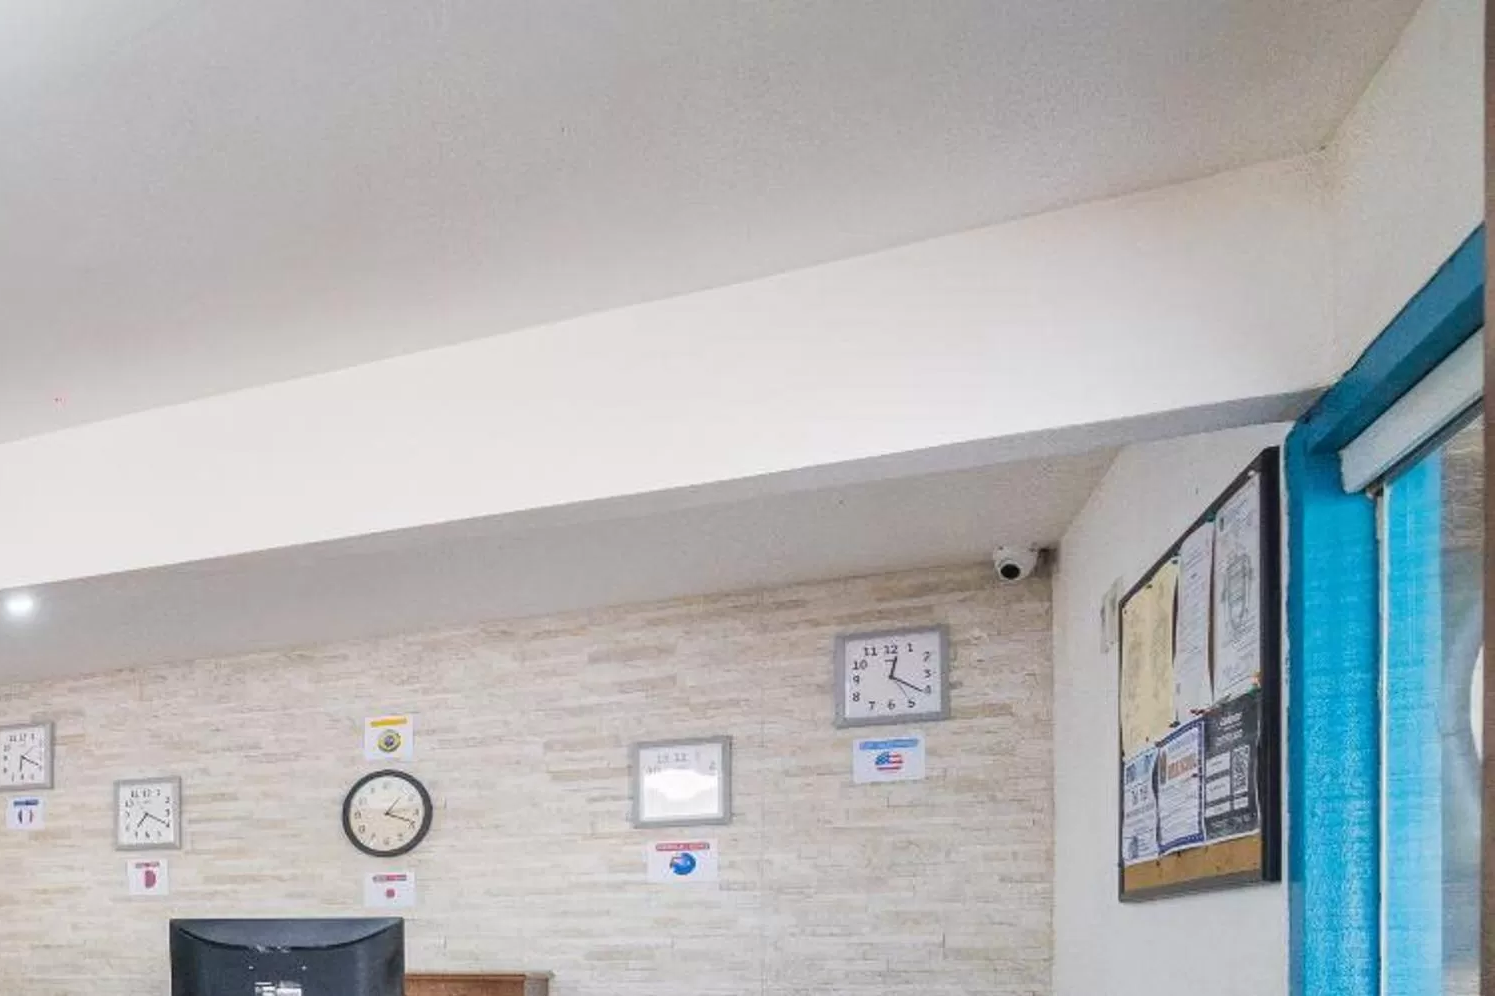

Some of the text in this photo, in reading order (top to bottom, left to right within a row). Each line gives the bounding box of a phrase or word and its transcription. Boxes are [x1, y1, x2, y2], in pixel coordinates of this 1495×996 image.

[864, 646, 878, 657] 11
[883, 644, 898, 655] 12
[852, 660, 868, 671] 10
[852, 675, 861, 685] 9
[852, 691, 861, 702] 8
[887, 699, 896, 711] 6
